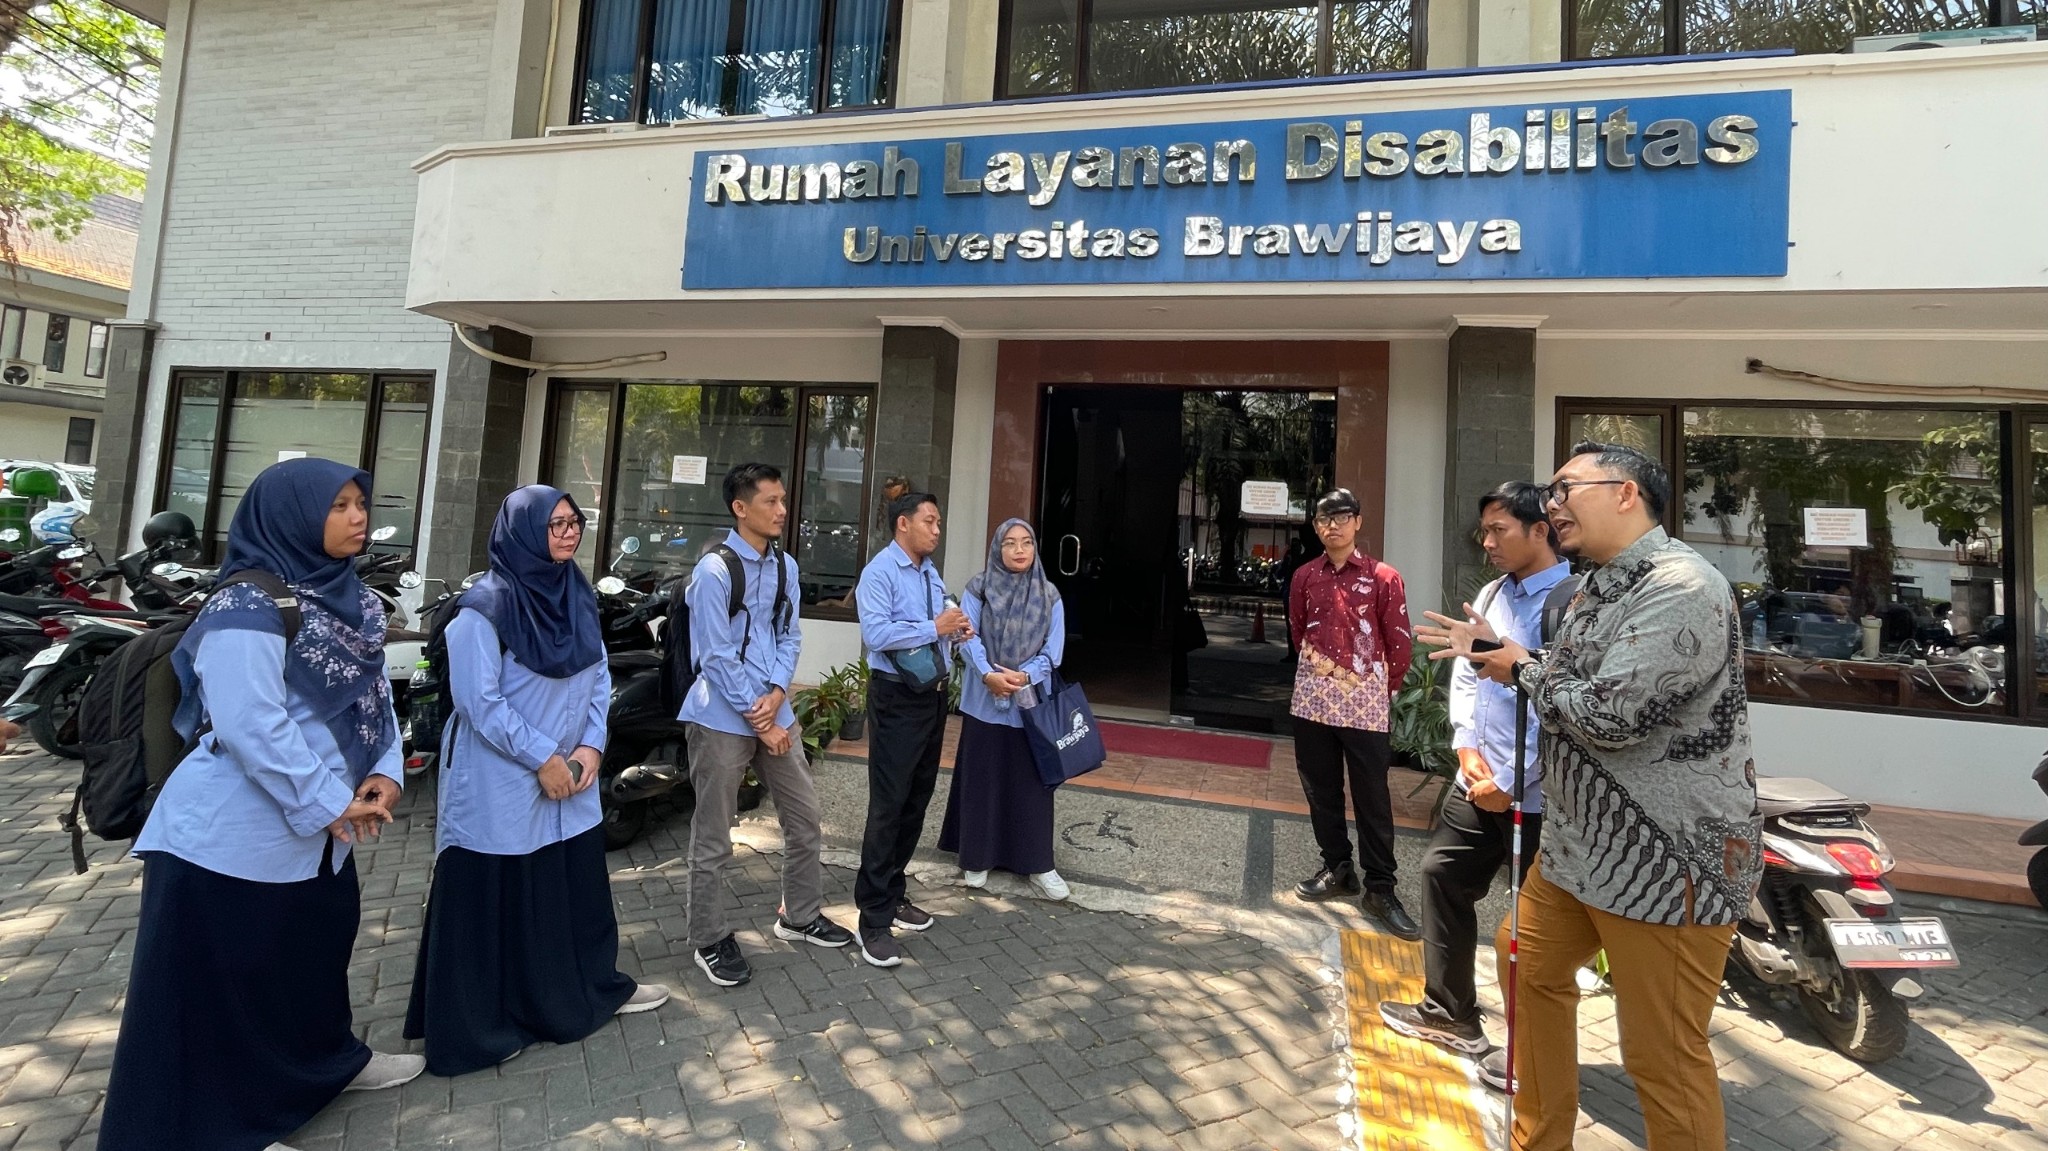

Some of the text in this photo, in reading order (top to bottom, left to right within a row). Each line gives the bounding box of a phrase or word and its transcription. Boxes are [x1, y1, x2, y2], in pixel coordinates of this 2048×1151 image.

[704, 105, 1760, 206] Rumah Layanan Disabilitas
[843, 211, 1522, 265] Universitas Brawijaya
